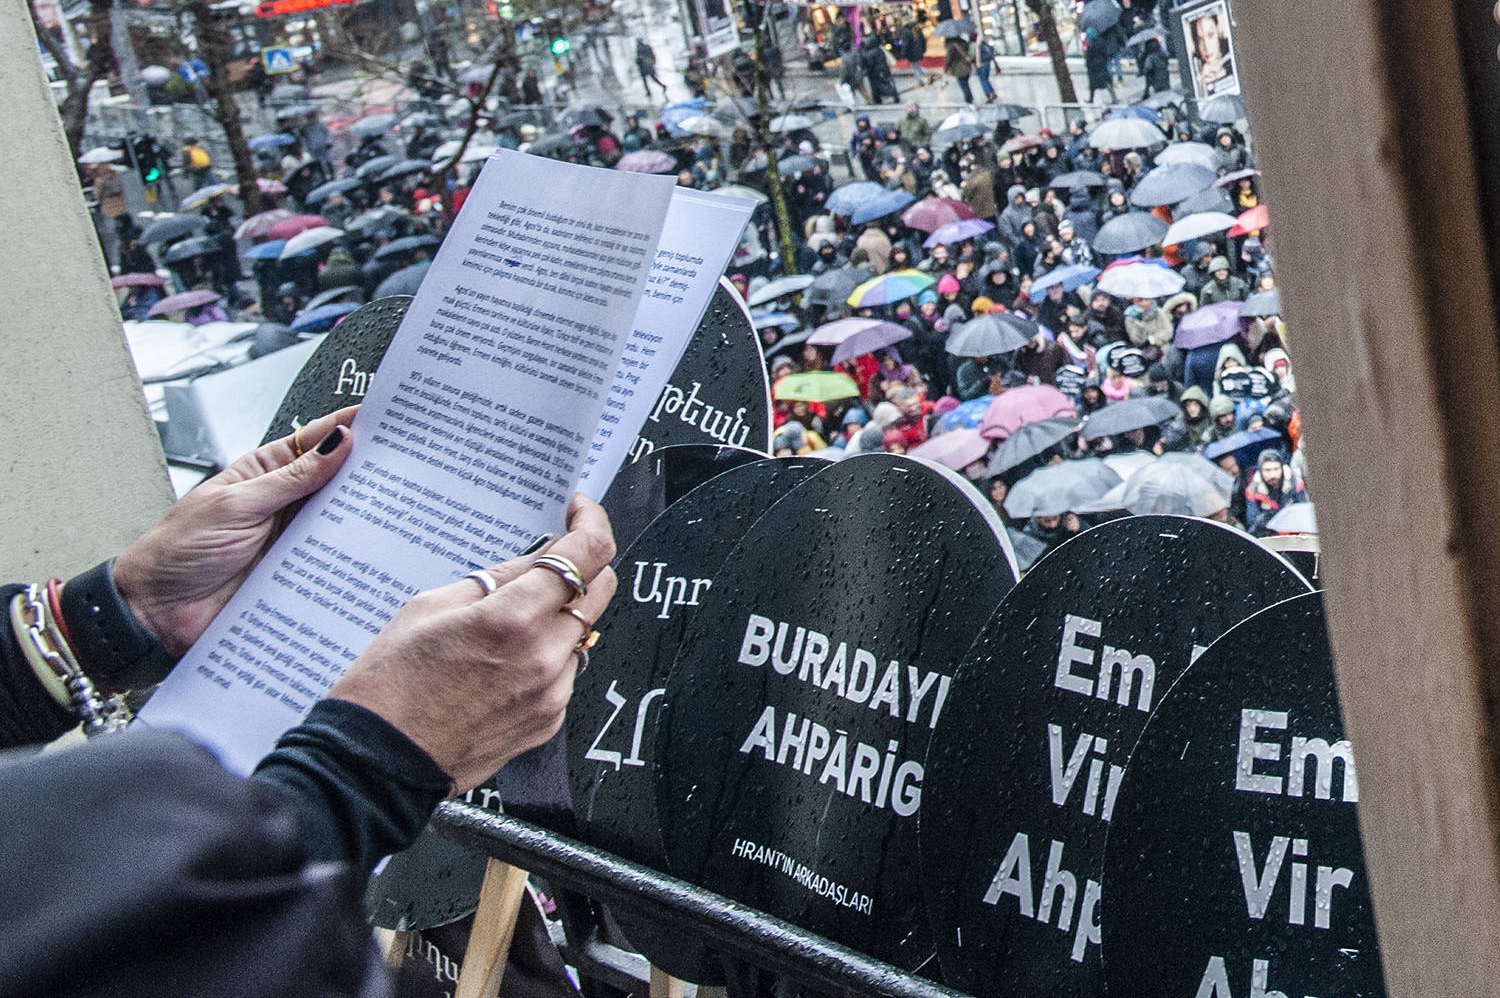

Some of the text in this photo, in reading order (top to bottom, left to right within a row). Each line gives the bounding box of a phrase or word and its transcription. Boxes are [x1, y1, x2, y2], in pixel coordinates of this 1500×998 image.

[1054, 613, 1156, 713] Em
[1234, 708, 1360, 804] Em
[731, 837, 874, 917] HRANT'IN ARKADAŞLARI
[1232, 830, 1355, 930] Vir
